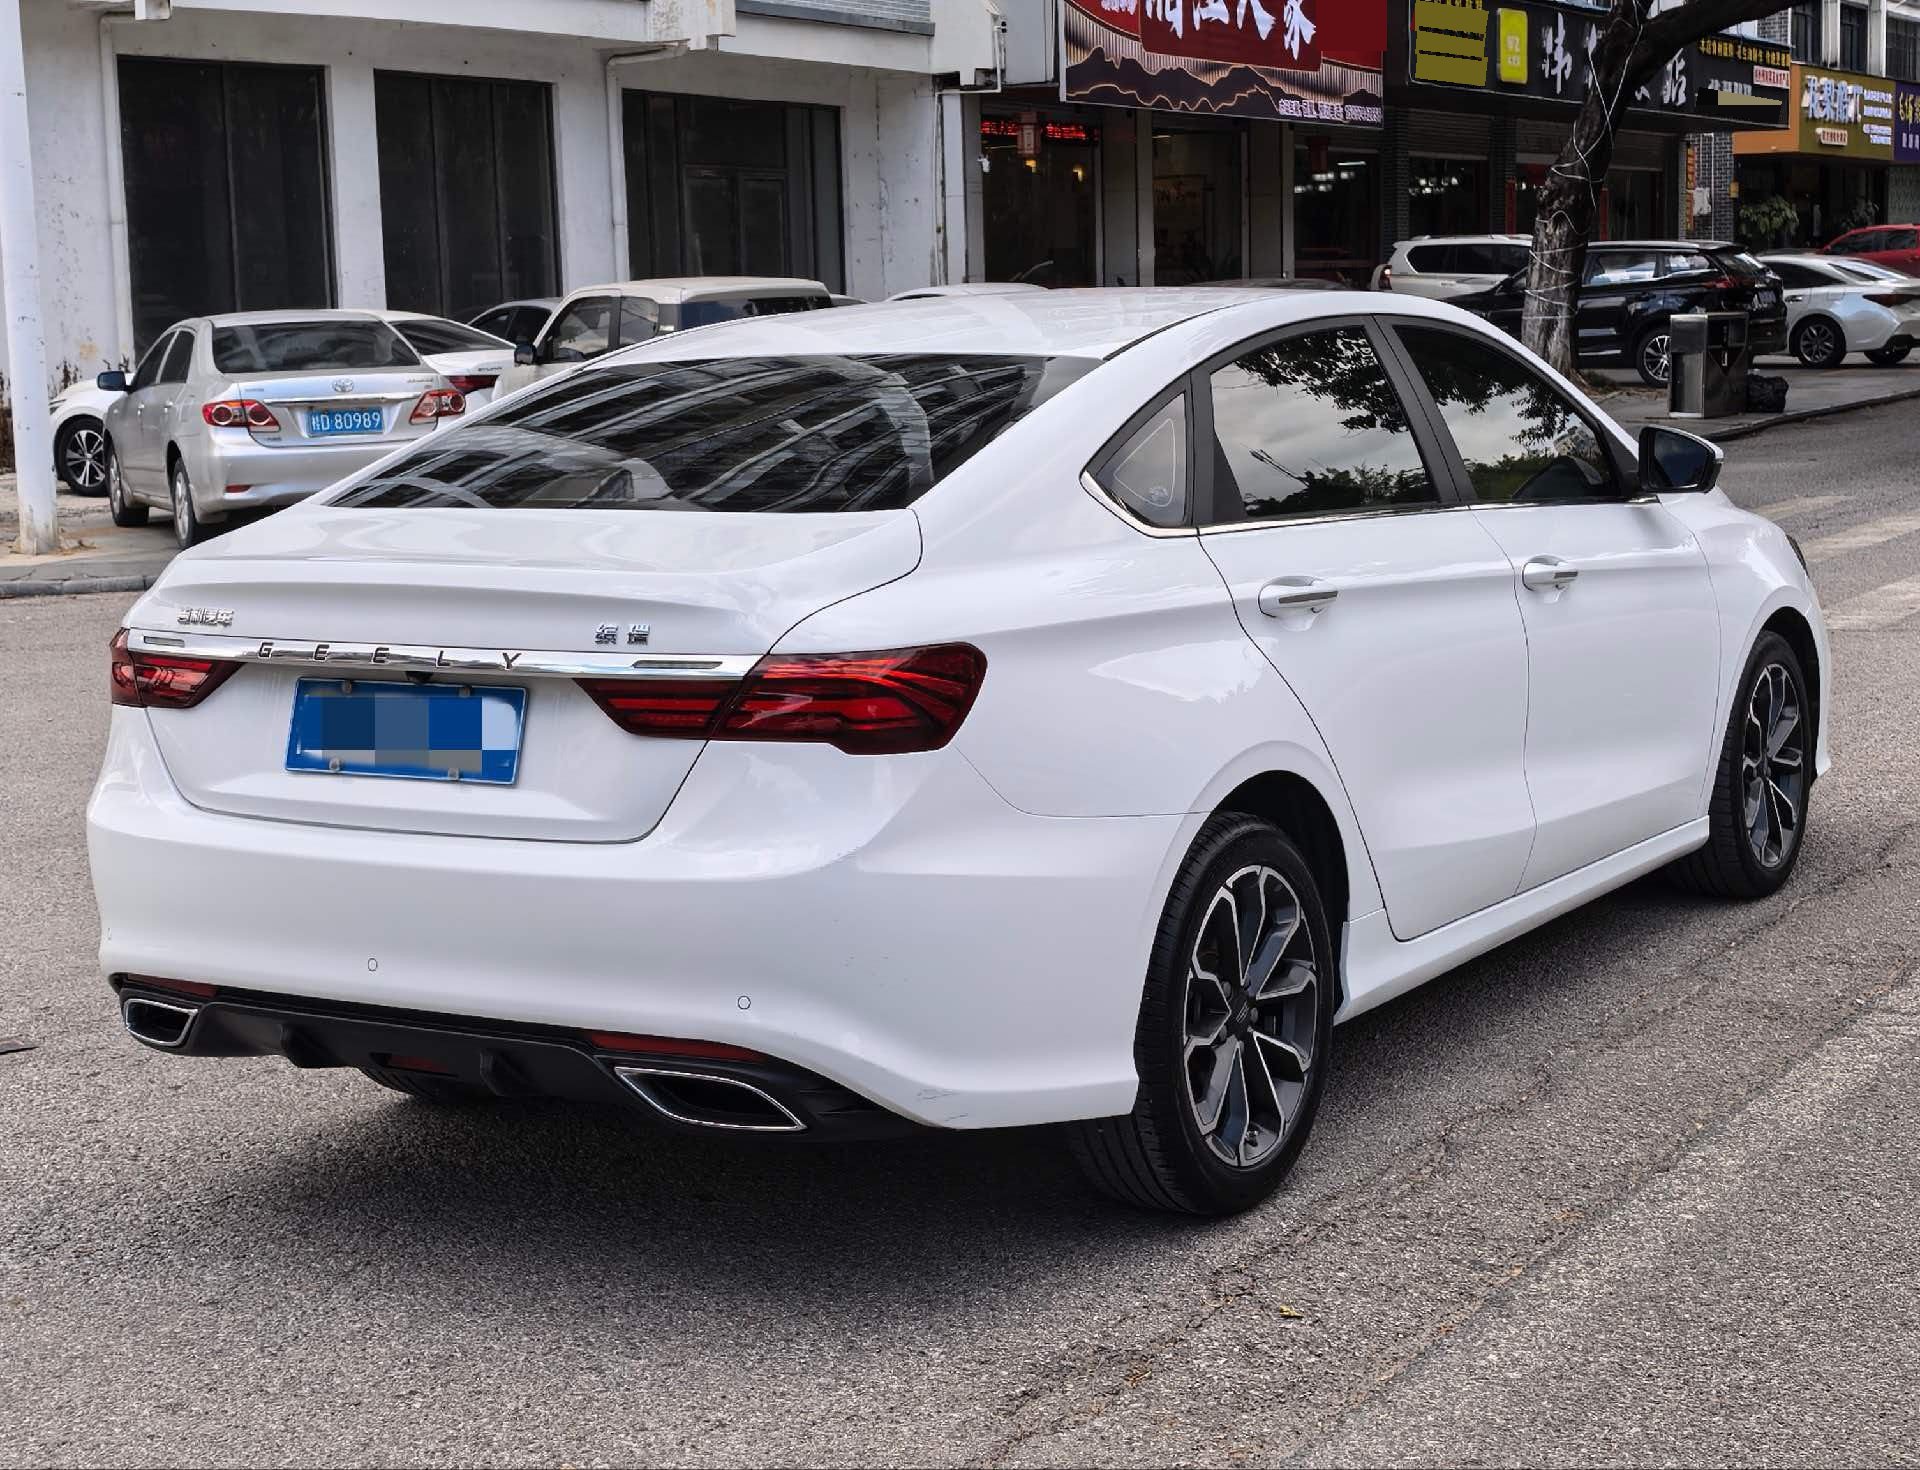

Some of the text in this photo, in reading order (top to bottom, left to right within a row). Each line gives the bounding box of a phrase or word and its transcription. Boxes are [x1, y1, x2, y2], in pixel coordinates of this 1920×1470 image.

[177, 607, 235, 627] 吉利汽车
[257, 640, 522, 671] GEELY
